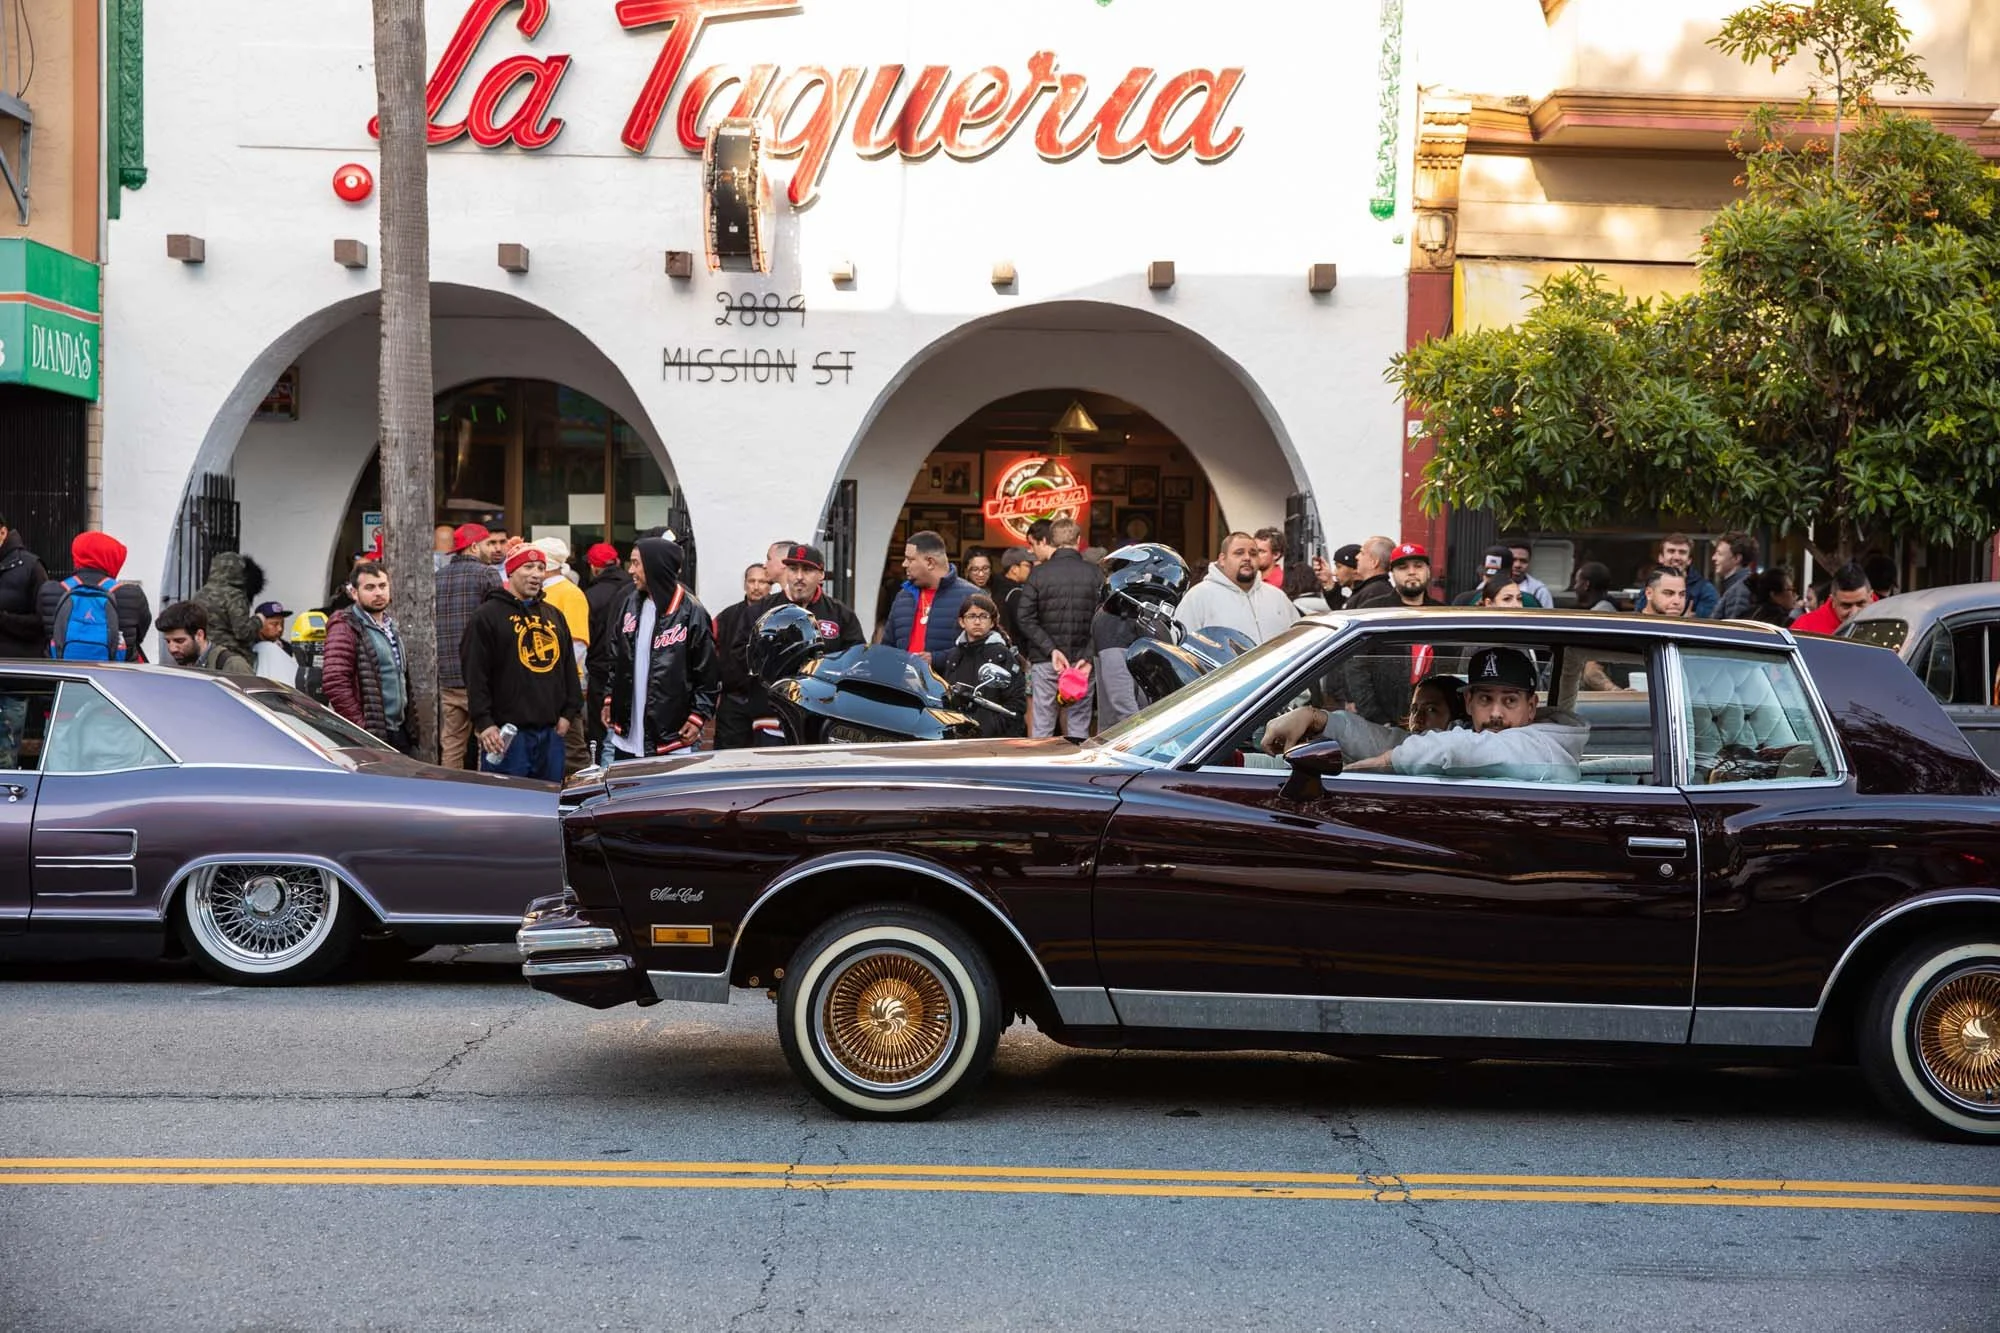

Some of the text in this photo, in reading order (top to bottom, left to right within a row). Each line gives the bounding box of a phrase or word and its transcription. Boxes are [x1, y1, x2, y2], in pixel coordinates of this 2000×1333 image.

[367, 0, 1245, 207] La Taqueria
[715, 291, 806, 328] 2889
[32, 323, 92, 381] DIANDA'S
[663, 347, 856, 385] MISSION ST
[1481, 652, 1498, 677] A
